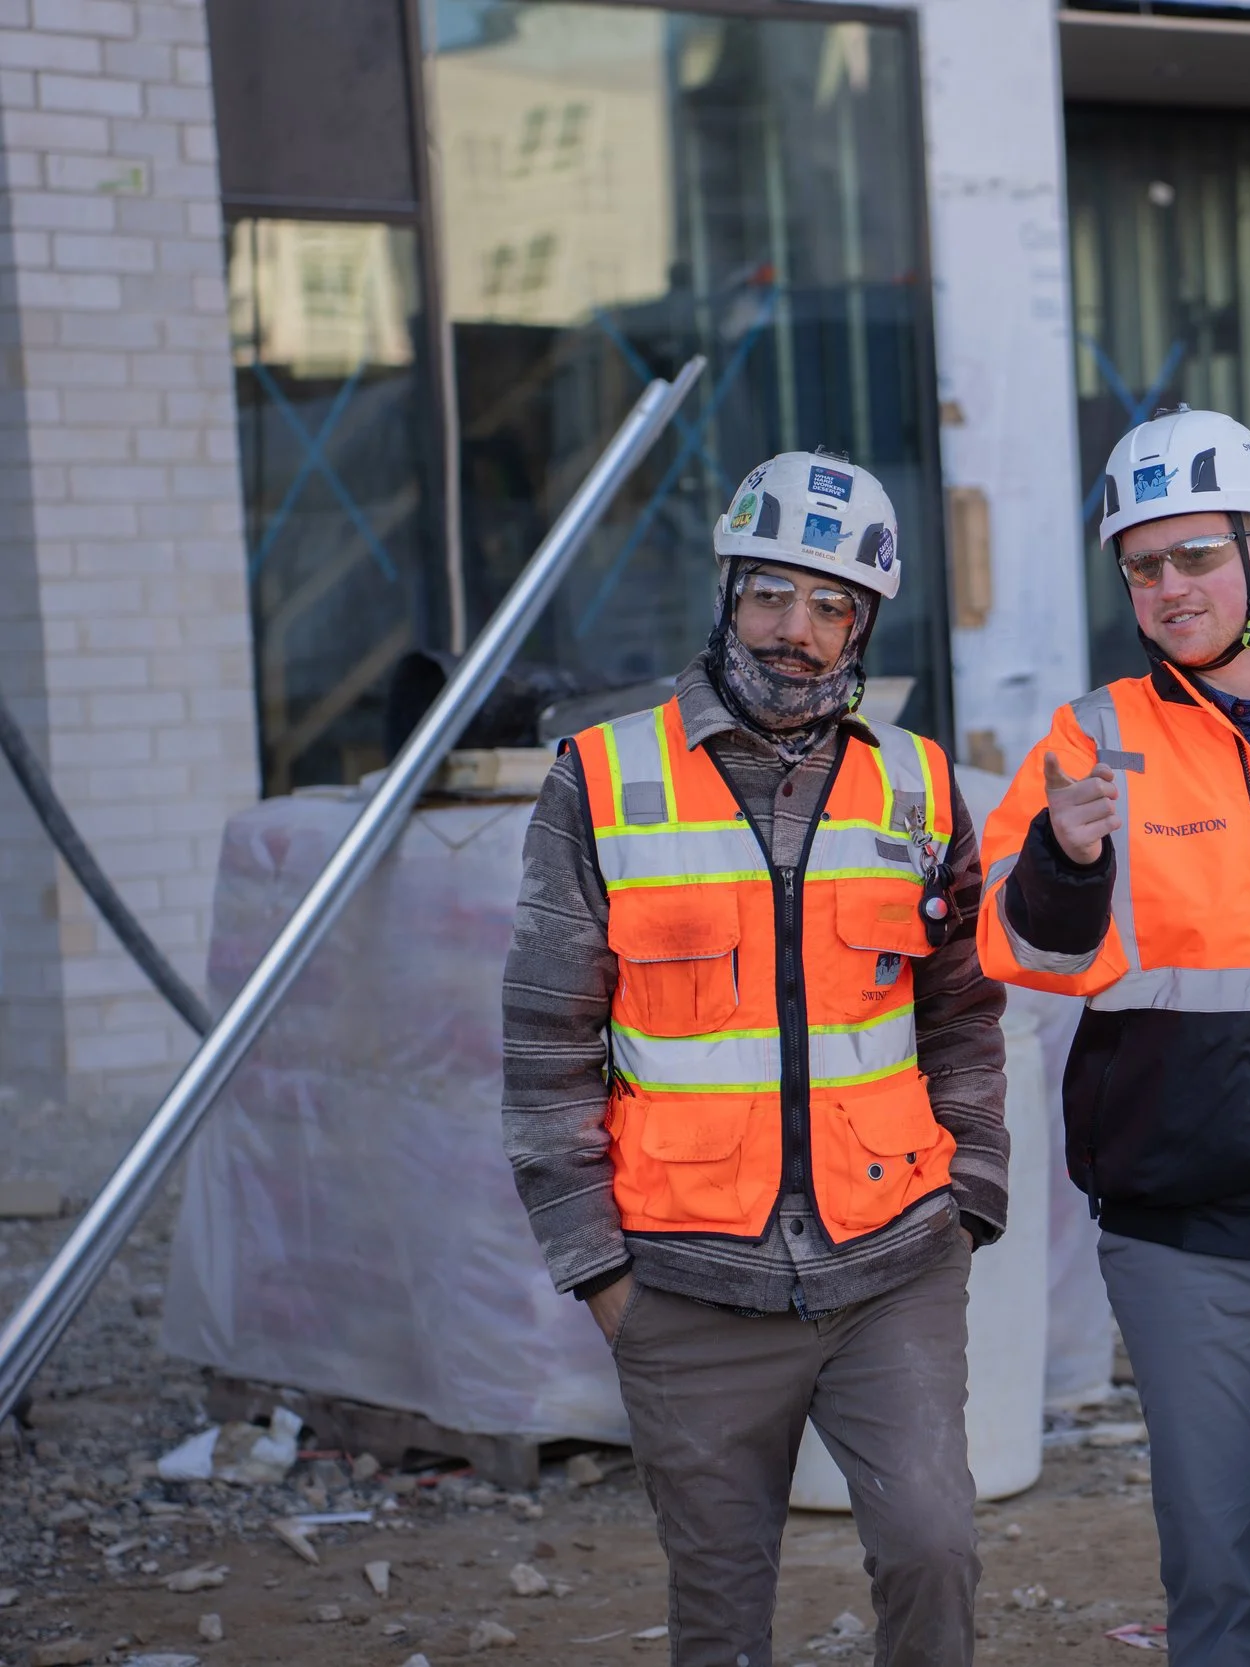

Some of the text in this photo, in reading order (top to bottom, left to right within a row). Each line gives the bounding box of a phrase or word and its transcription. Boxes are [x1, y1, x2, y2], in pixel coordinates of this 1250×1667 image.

[814, 473, 834, 481] WHAT
[814, 477, 833, 485] HARD
[812, 485, 842, 497] DESERVE
[813, 481, 846, 494] WORKERS
[1144, 819, 1227, 836] SWINERTON
